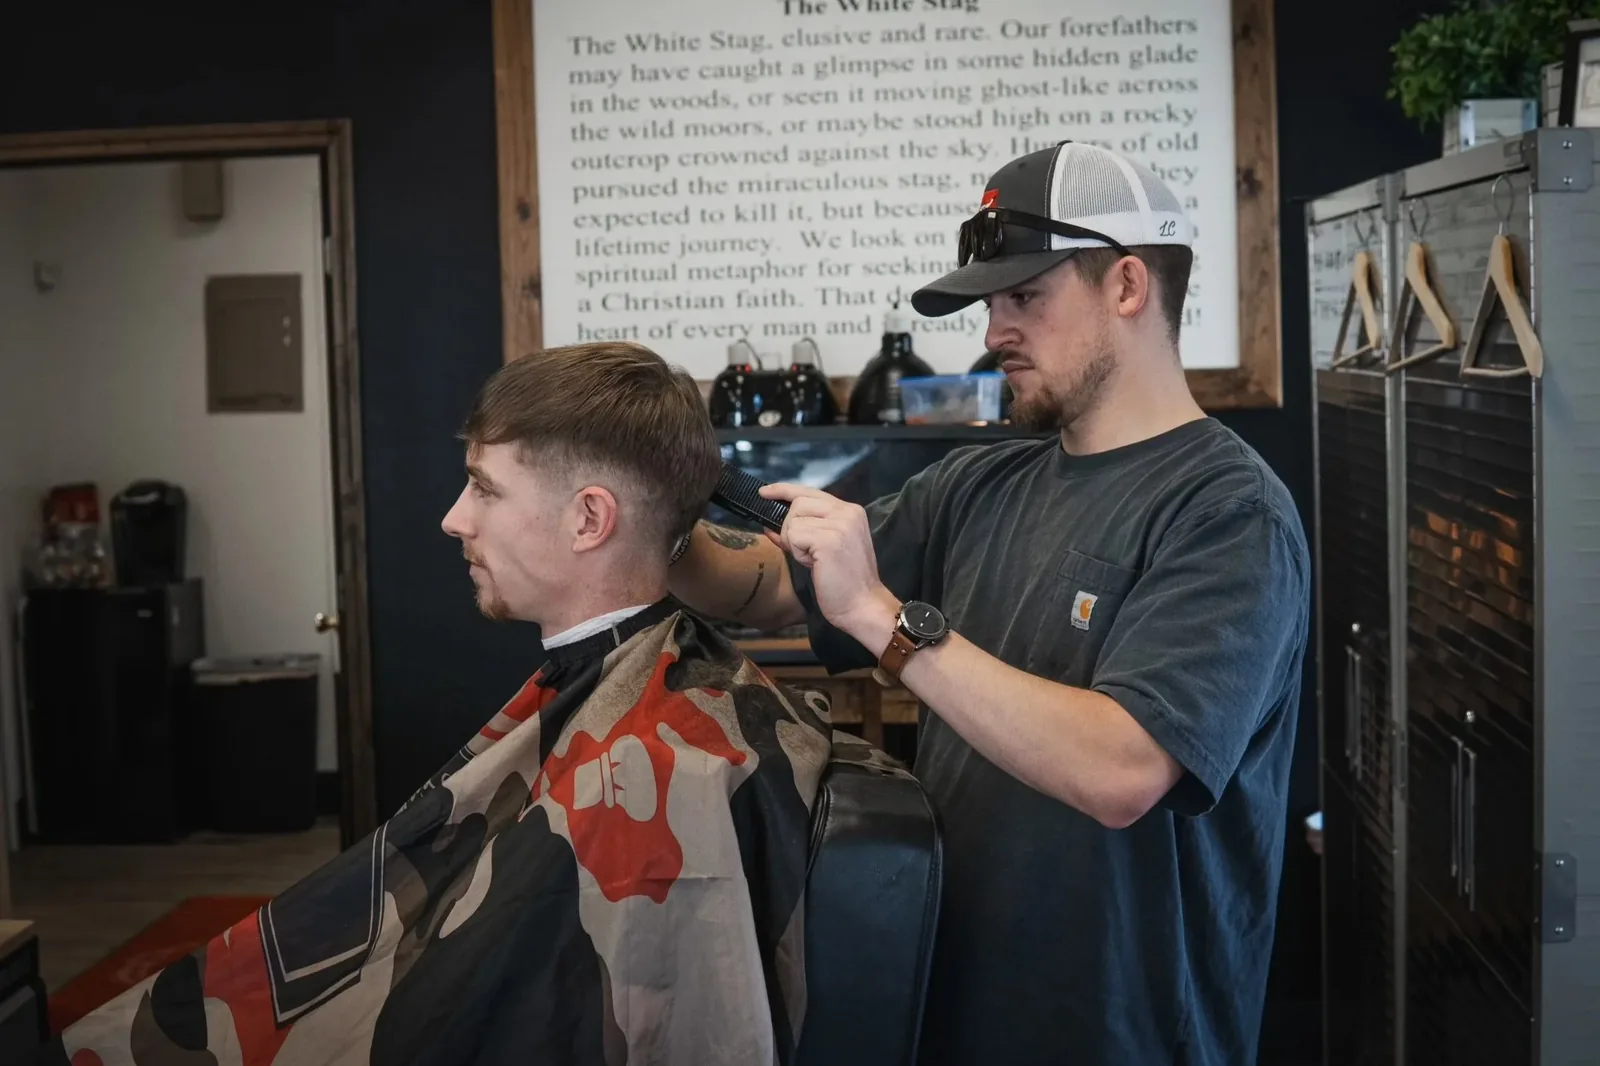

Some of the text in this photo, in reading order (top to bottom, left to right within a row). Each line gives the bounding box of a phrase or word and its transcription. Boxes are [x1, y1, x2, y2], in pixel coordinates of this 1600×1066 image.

[773, 0, 980, 14] The White Stag
[566, 36, 617, 55] The
[625, 34, 701, 52] White
[781, 28, 871, 47] elusive
[880, 24, 926, 43] and
[999, 21, 1049, 38] Our
[1060, 15, 1199, 36] forefathers
[568, 44, 1199, 88] may have caught a glimpse in some hidden glade
[570, 95, 593, 114] in
[602, 94, 640, 112] the
[747, 93, 772, 106] or
[782, 91, 839, 105] seen
[849, 88, 865, 102] it
[874, 86, 971, 104] moving
[980, 77, 1109, 102] ghost-like
[1118, 80, 1199, 94] across
[570, 123, 610, 141] the
[619, 120, 676, 138] wild
[780, 120, 807, 133] or
[817, 113, 903, 136] maybe
[913, 109, 983, 128] stood
[992, 107, 1050, 131] high
[1058, 111, 1091, 125] on
[1100, 112, 1115, 124] a
[1123, 104, 1199, 126] rocky
[571, 154, 670, 172] outcrop
[677, 146, 790, 166] crowned
[798, 145, 889, 166] against
[899, 140, 938, 158] the
[1121, 135, 1149, 152] of
[1155, 132, 1200, 151] old
[572, 178, 678, 204] pursued
[688, 177, 729, 195] the
[738, 173, 889, 192] miraculous
[573, 206, 690, 232] expected
[700, 209, 726, 223] to
[734, 203, 777, 222] kill
[822, 202, 864, 219] but
[874, 200, 980, 219] because
[575, 239, 671, 257] lifetime
[799, 231, 842, 249] We
[851, 229, 904, 247] look
[914, 233, 945, 246] on
[576, 264, 677, 288] spiritual
[687, 261, 806, 284] metaphor
[818, 260, 852, 276] for
[578, 300, 593, 313] a
[600, 293, 725, 311] Christian
[815, 287, 876, 305] That
[577, 323, 639, 342] heart
[648, 322, 676, 339] of
[682, 324, 753, 344] every
[763, 323, 817, 336] man
[826, 316, 872, 334] and
